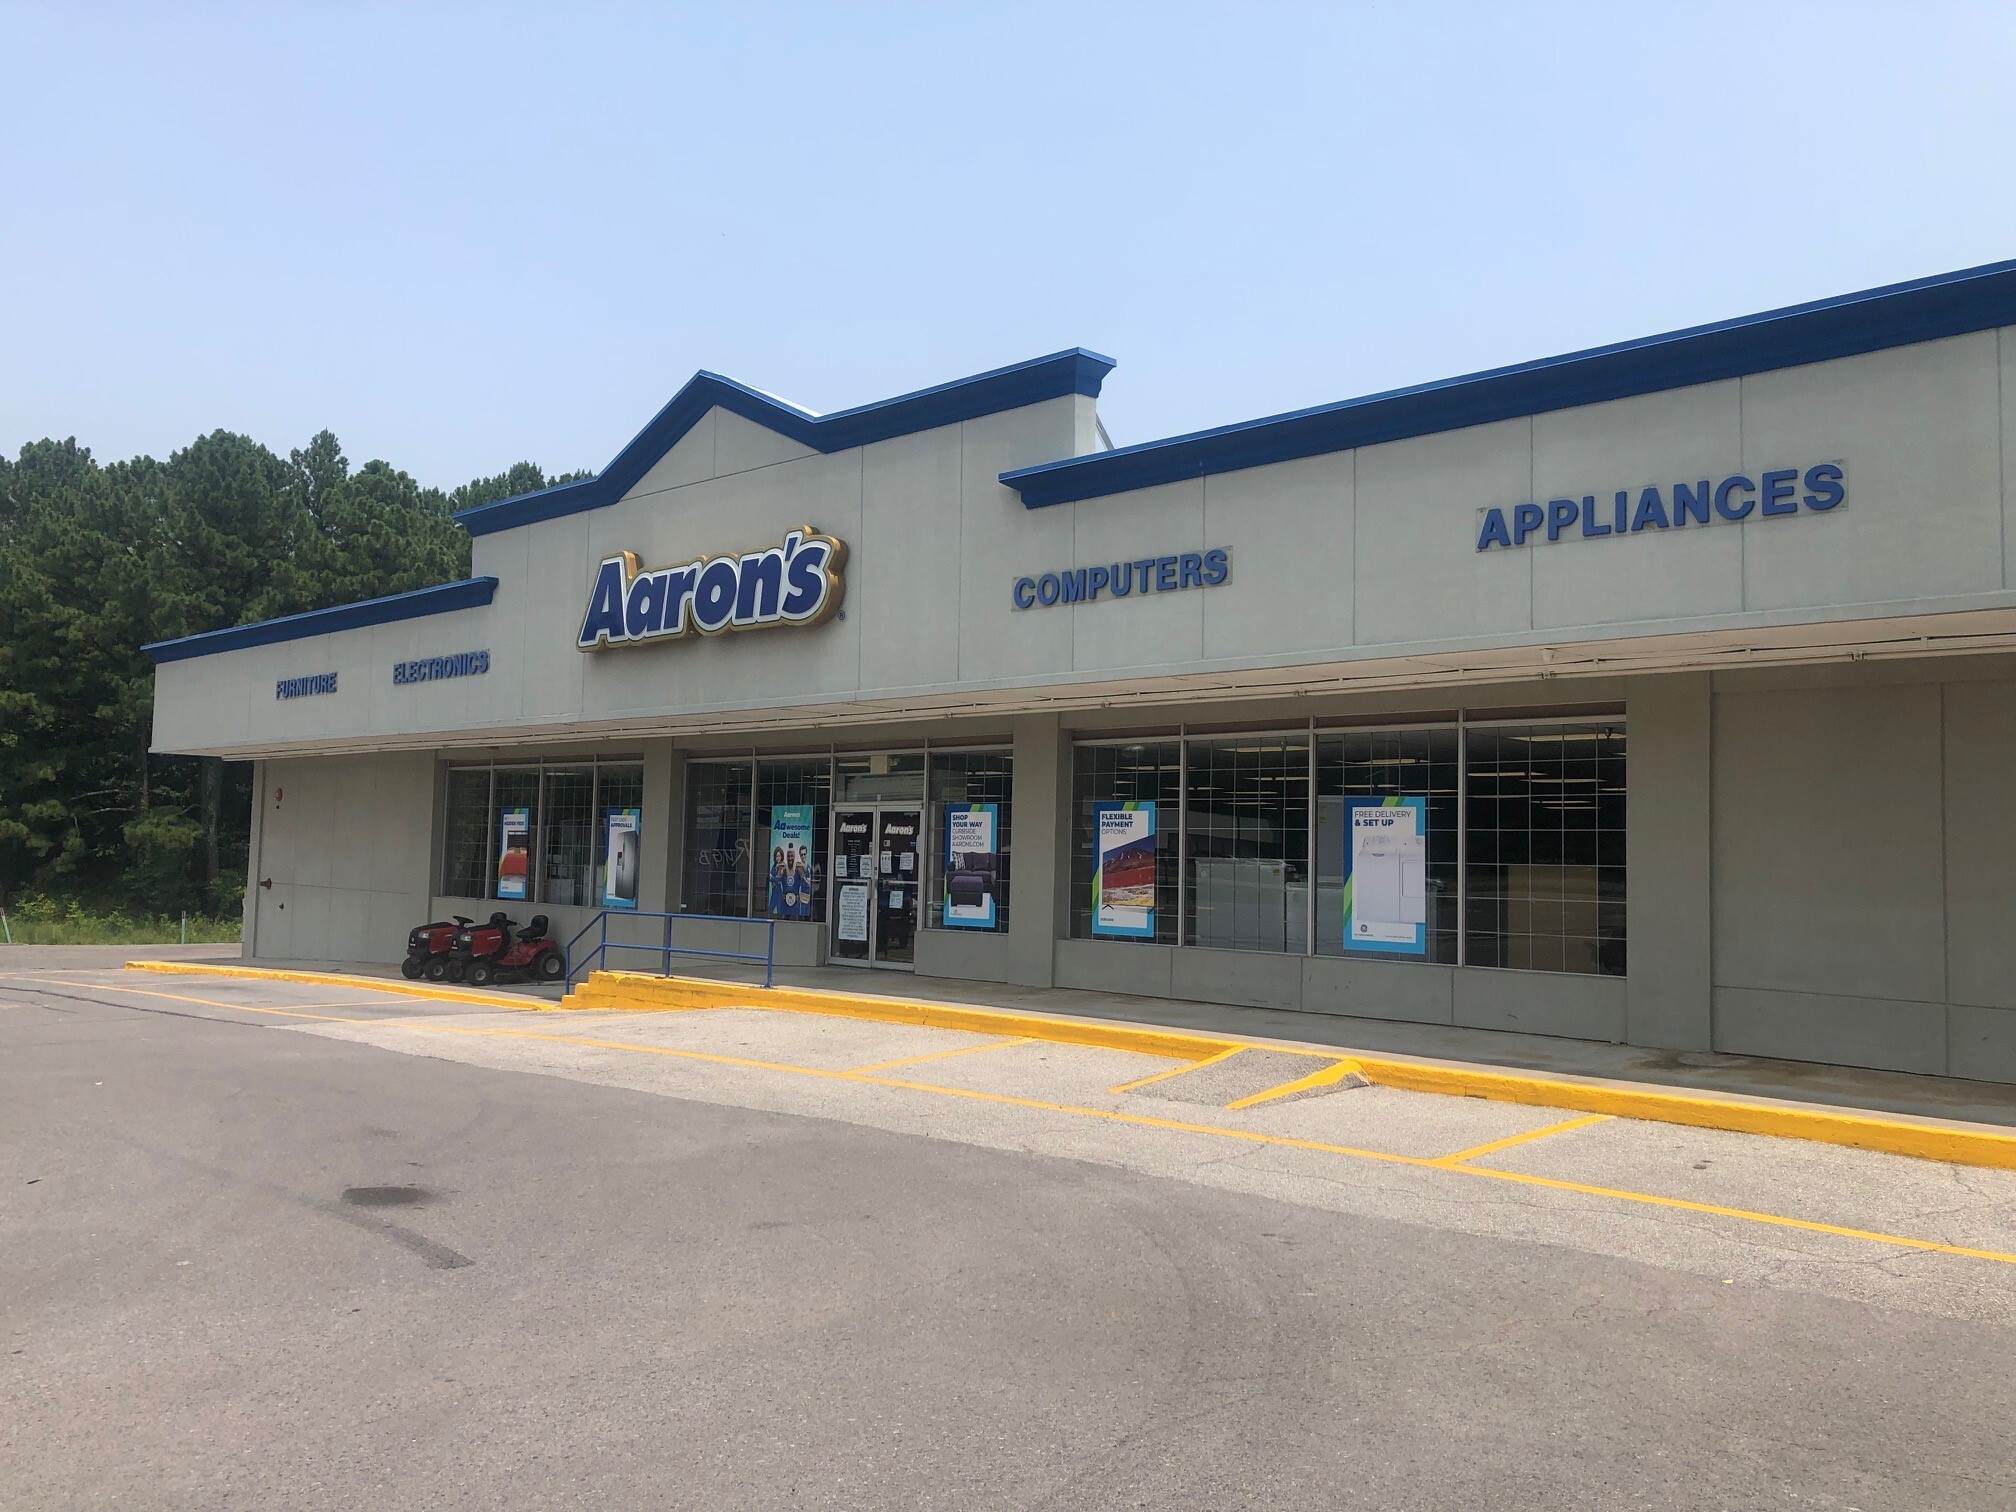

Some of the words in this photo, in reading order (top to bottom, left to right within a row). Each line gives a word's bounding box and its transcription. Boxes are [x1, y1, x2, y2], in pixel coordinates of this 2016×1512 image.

[1477, 463, 1845, 550] APPLIANCES
[578, 530, 832, 648] Aaron's
[1013, 549, 1229, 609] COMPUTERS
[392, 650, 490, 685] ELECTRONICS
[276, 671, 338, 700] FURNITURE
[1354, 810, 1373, 818] FREE
[1375, 810, 1411, 818] DELIVERY
[1354, 819, 1361, 827] &
[1363, 819, 1379, 827] SET
[1381, 819, 1395, 827] UP
[782, 831, 800, 839] Deals!
[839, 821, 868, 834] Aaron's
[884, 823, 915, 836] Aaron's
